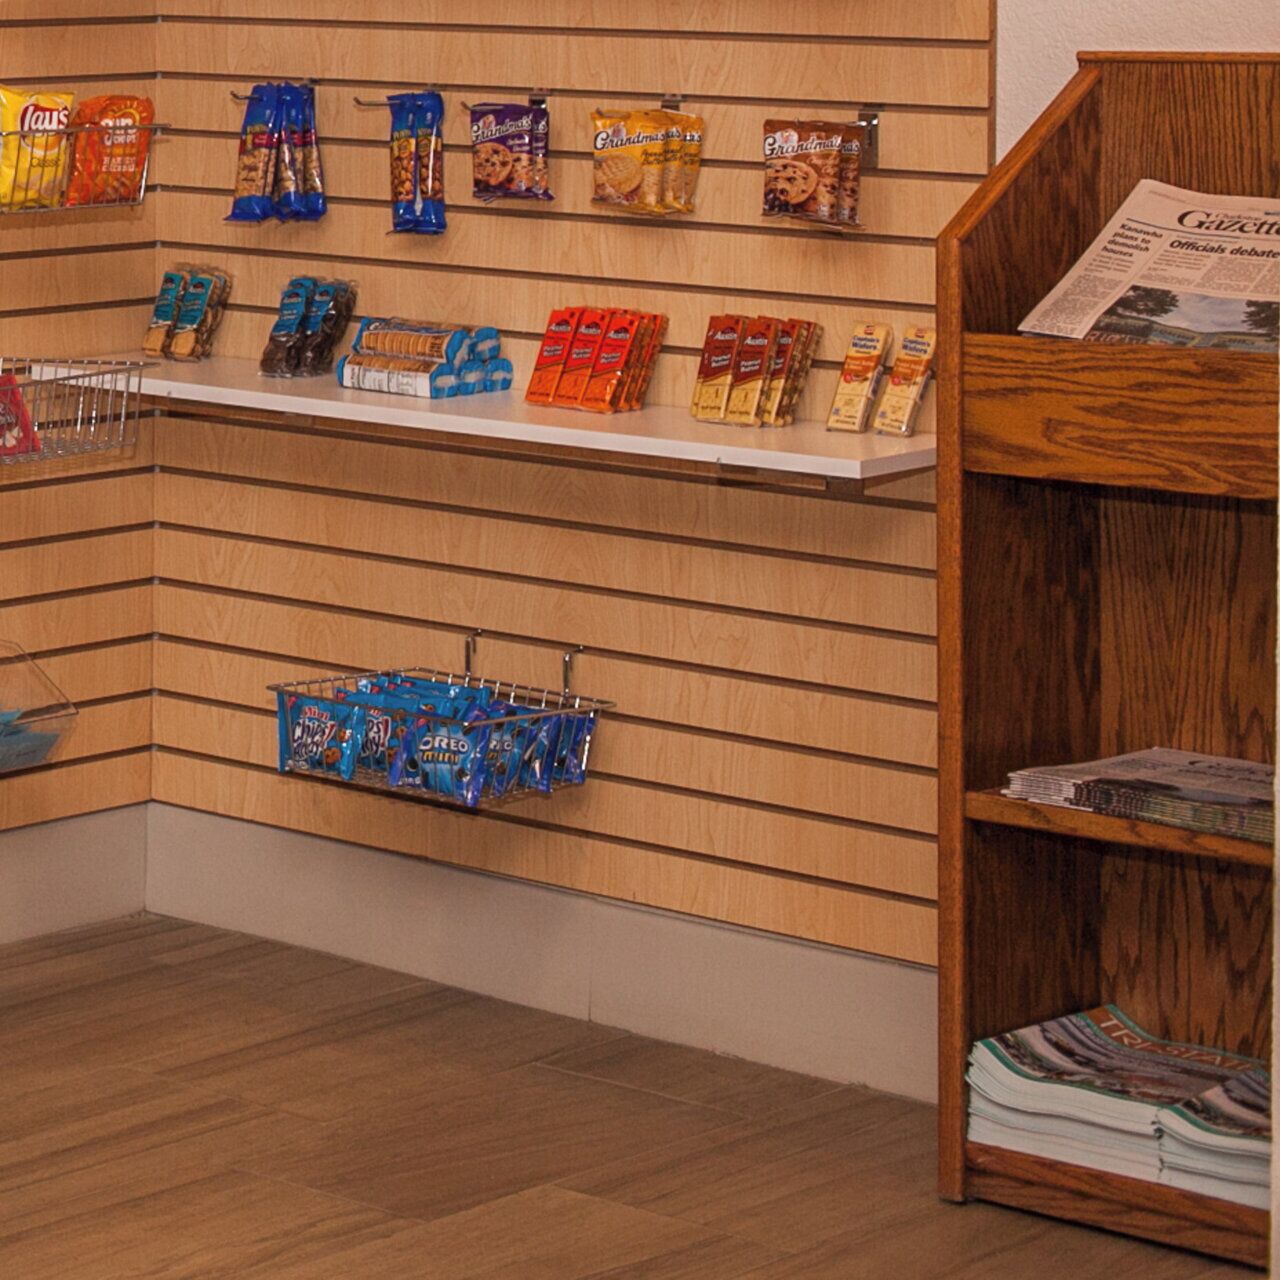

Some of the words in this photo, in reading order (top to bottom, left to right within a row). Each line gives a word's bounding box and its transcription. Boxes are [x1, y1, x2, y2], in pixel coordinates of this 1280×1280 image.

[594, 128, 666, 151] Grandma's
[1113, 231, 1138, 243] plans
[1141, 236, 1151, 244] to
[1120, 223, 1163, 239] Kanawha
[1101, 246, 1133, 258] houses
[1107, 238, 1150, 253] demolish
[1169, 239, 1226, 255] Officials
[1229, 246, 1279, 259] debate
[419, 736, 470, 752] OREO
